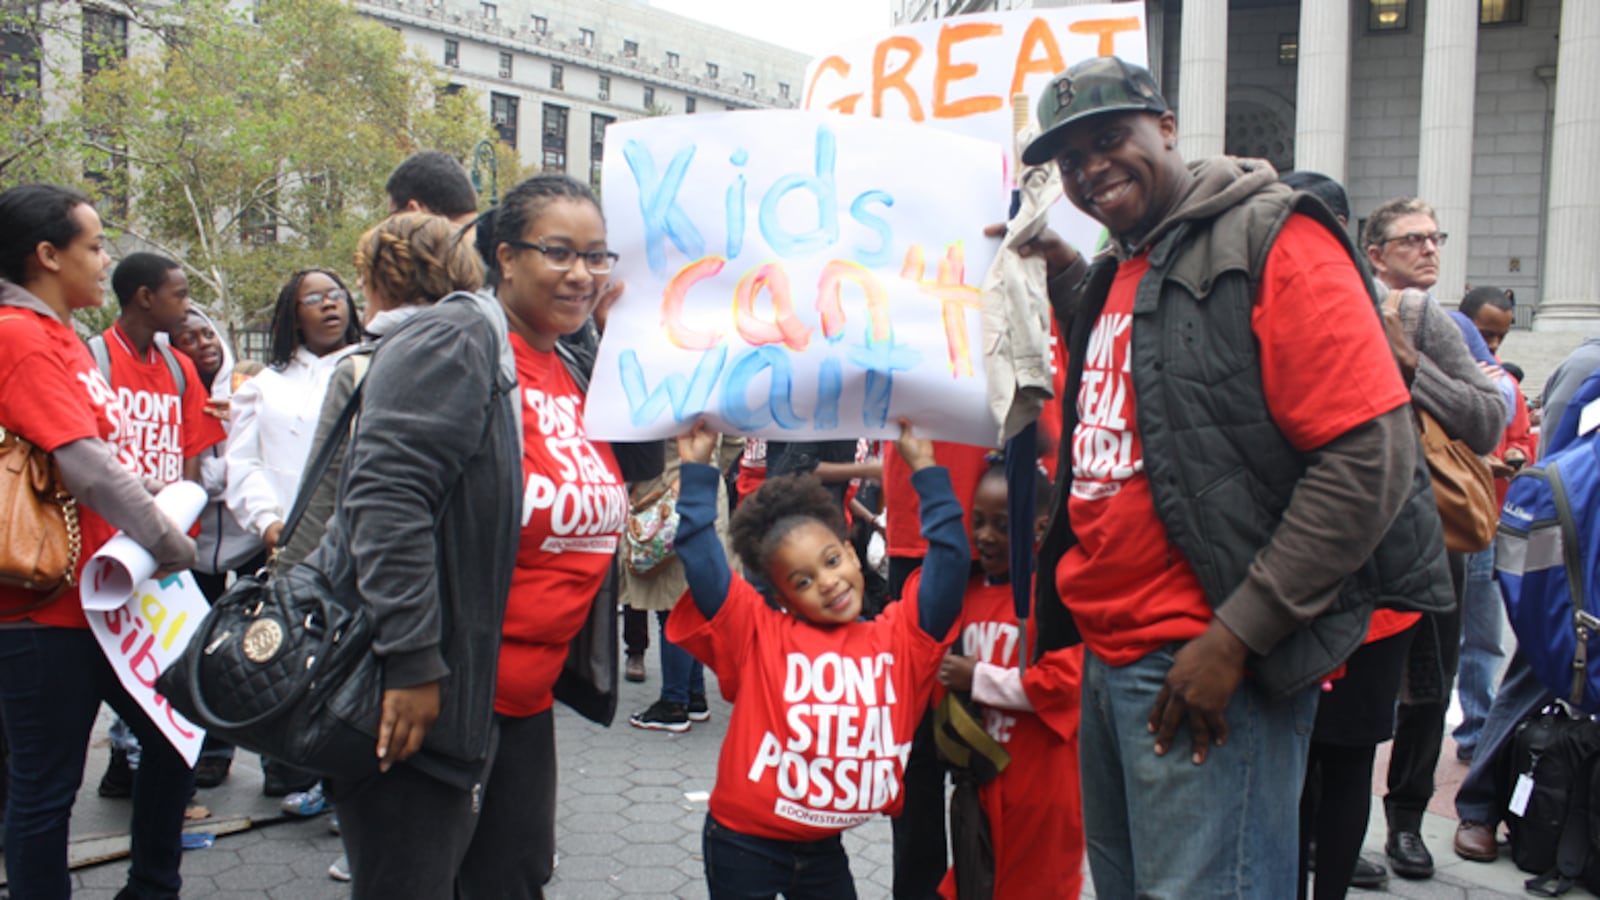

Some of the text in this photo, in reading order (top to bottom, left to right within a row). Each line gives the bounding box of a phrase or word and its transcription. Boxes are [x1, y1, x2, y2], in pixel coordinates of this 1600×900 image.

[805, 15, 1141, 123] GREAT
[622, 124, 894, 276] Kids
[661, 239, 982, 379] can't
[118, 386, 182, 424] DON'T
[618, 324, 924, 432] wait
[131, 420, 182, 454] TEAL
[783, 651, 898, 707] DON'T
[786, 703, 900, 759] STEAL
